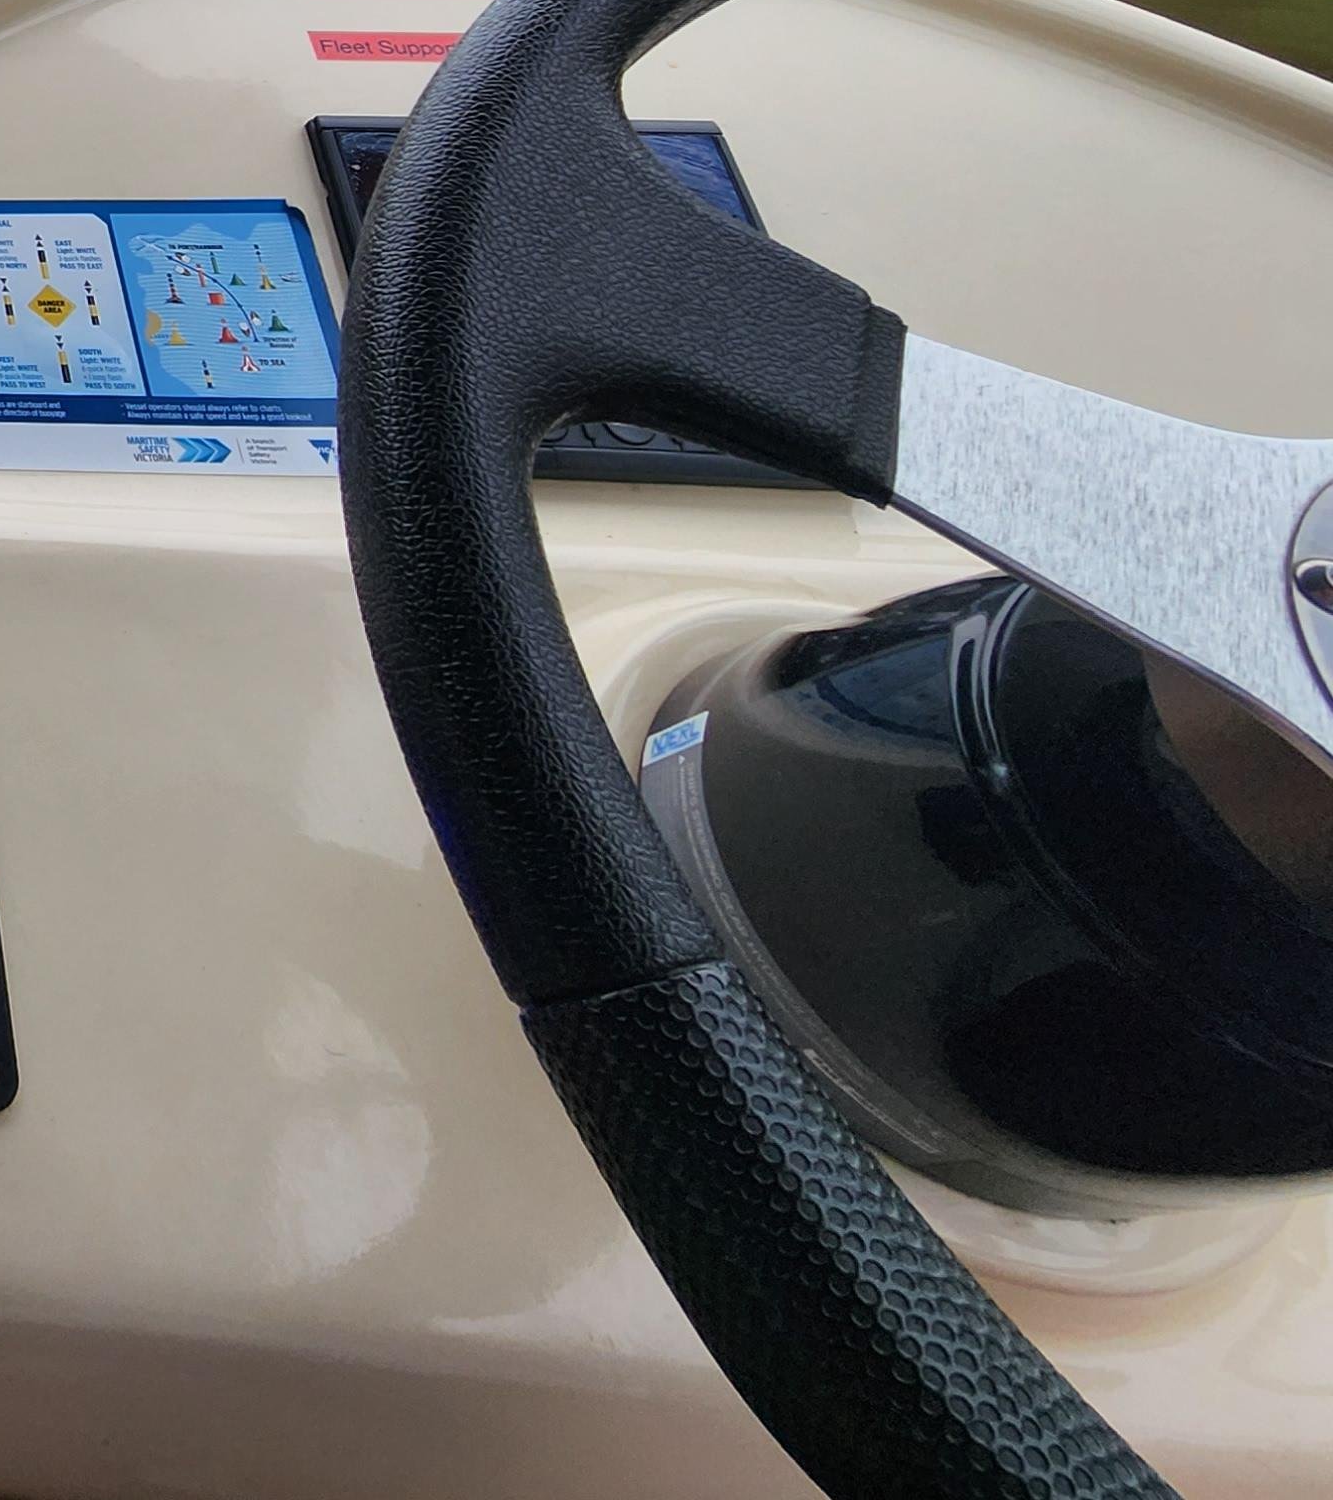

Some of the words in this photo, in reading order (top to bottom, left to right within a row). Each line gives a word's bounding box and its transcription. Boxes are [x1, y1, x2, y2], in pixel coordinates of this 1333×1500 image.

[320, 38, 373, 56] Fleet
[125, 403, 148, 411] Vessel
[148, 404, 182, 412] operators
[182, 404, 206, 412] should
[207, 404, 231, 413] always
[231, 404, 249, 412] refer
[250, 404, 258, 412] to
[259, 405, 282, 413] charts
[127, 411, 151, 420] Always
[151, 412, 183, 420] maintain
[190, 412, 205, 420] safe
[206, 412, 227, 421] speed
[227, 412, 241, 420] and
[242, 412, 260, 421] keep
[266, 413, 285, 422] good
[285, 413, 313, 421] lookout
[126, 436, 168, 445] MARITIME
[138, 445, 170, 453] SAFETY
[133, 453, 173, 462] VICTORIA
